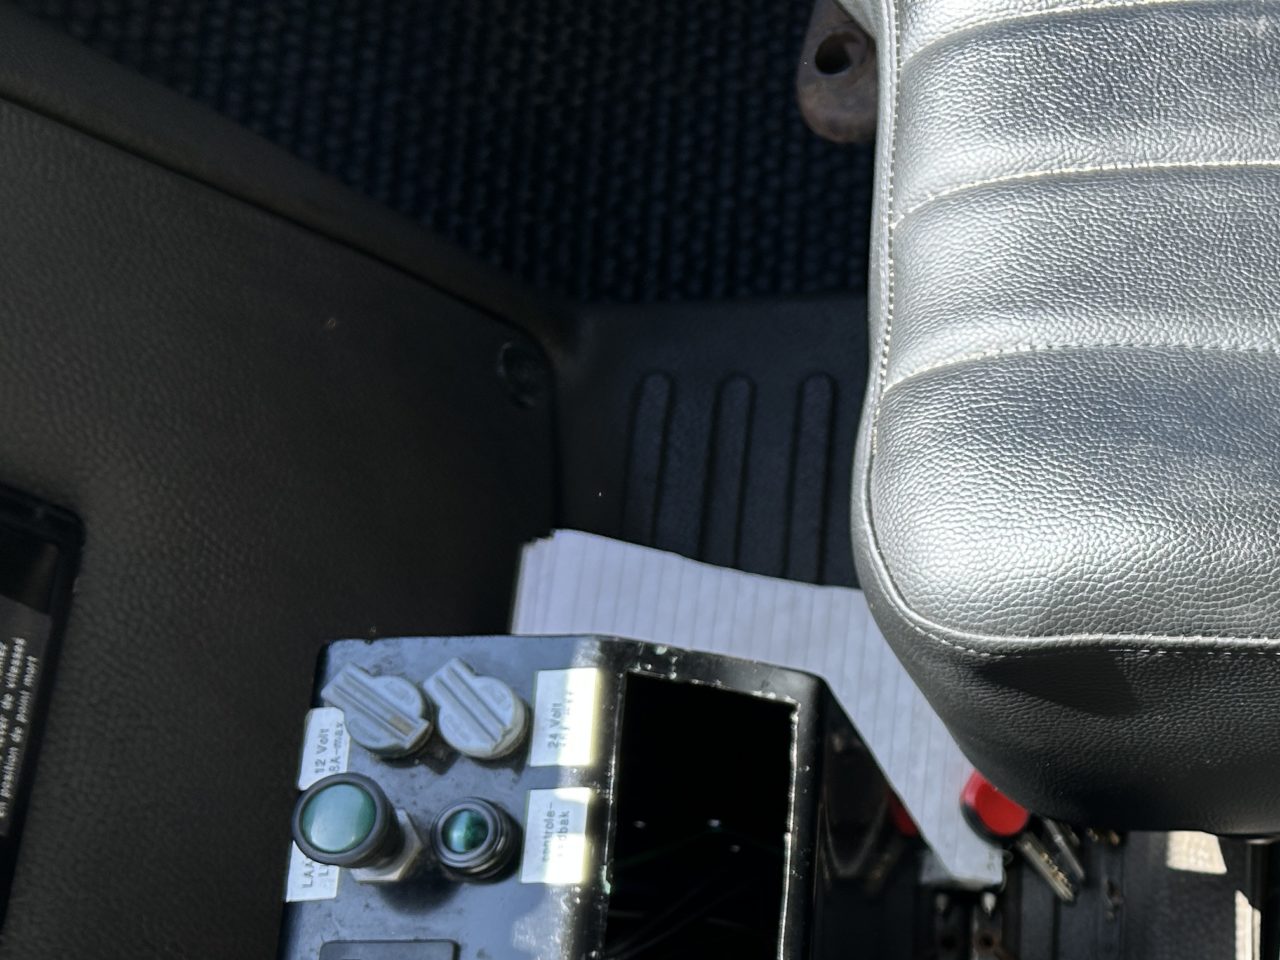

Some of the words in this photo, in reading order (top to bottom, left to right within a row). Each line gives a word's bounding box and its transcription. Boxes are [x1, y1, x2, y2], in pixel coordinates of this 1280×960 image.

[549, 702, 563, 729] Volt
[316, 728, 330, 755] Volt
[548, 732, 559, 750] 24
[0, 746, 19, 798] position
[314, 757, 327, 774] 12
